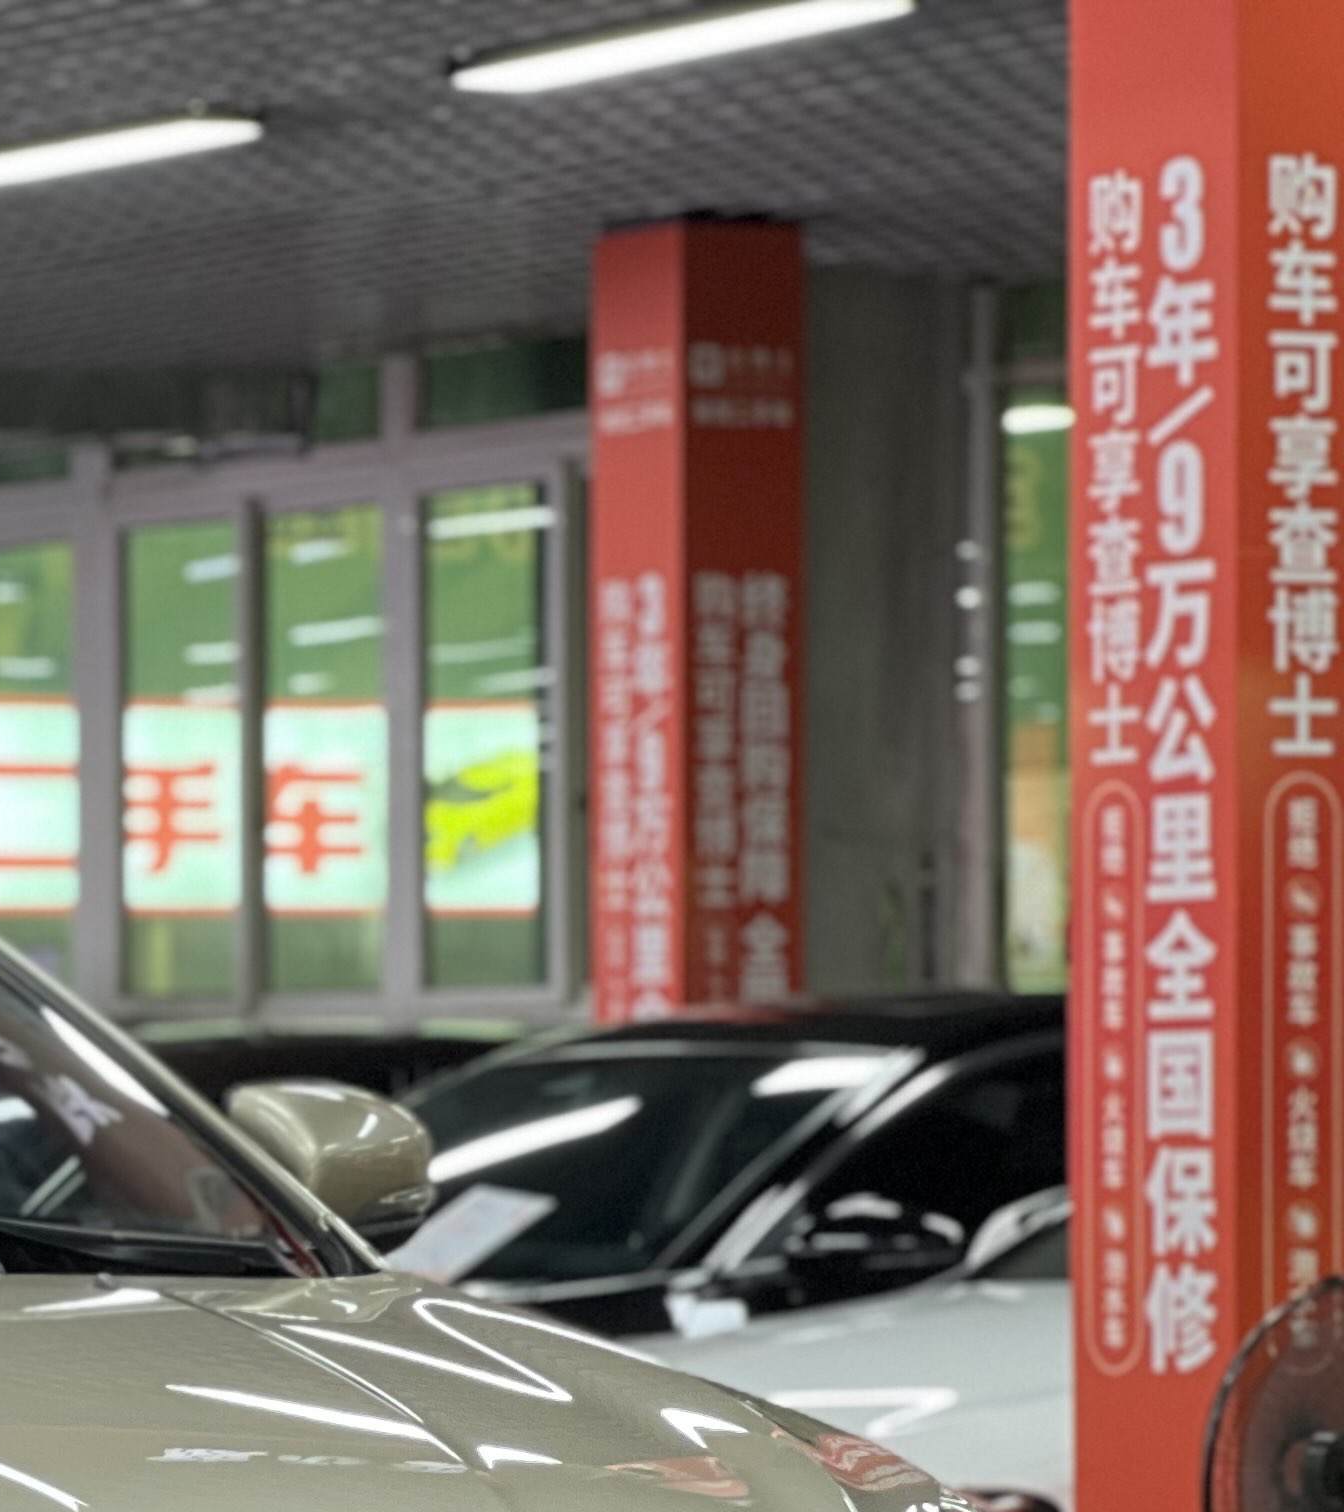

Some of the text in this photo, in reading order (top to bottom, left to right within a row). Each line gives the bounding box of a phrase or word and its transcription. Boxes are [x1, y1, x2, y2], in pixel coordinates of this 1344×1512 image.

[1088, 169, 1142, 766] 购车可享查博士
[1267, 153, 1340, 757] 购车可享查博士
[1145, 156, 1218, 1374] 3年/9万公里全国保修
